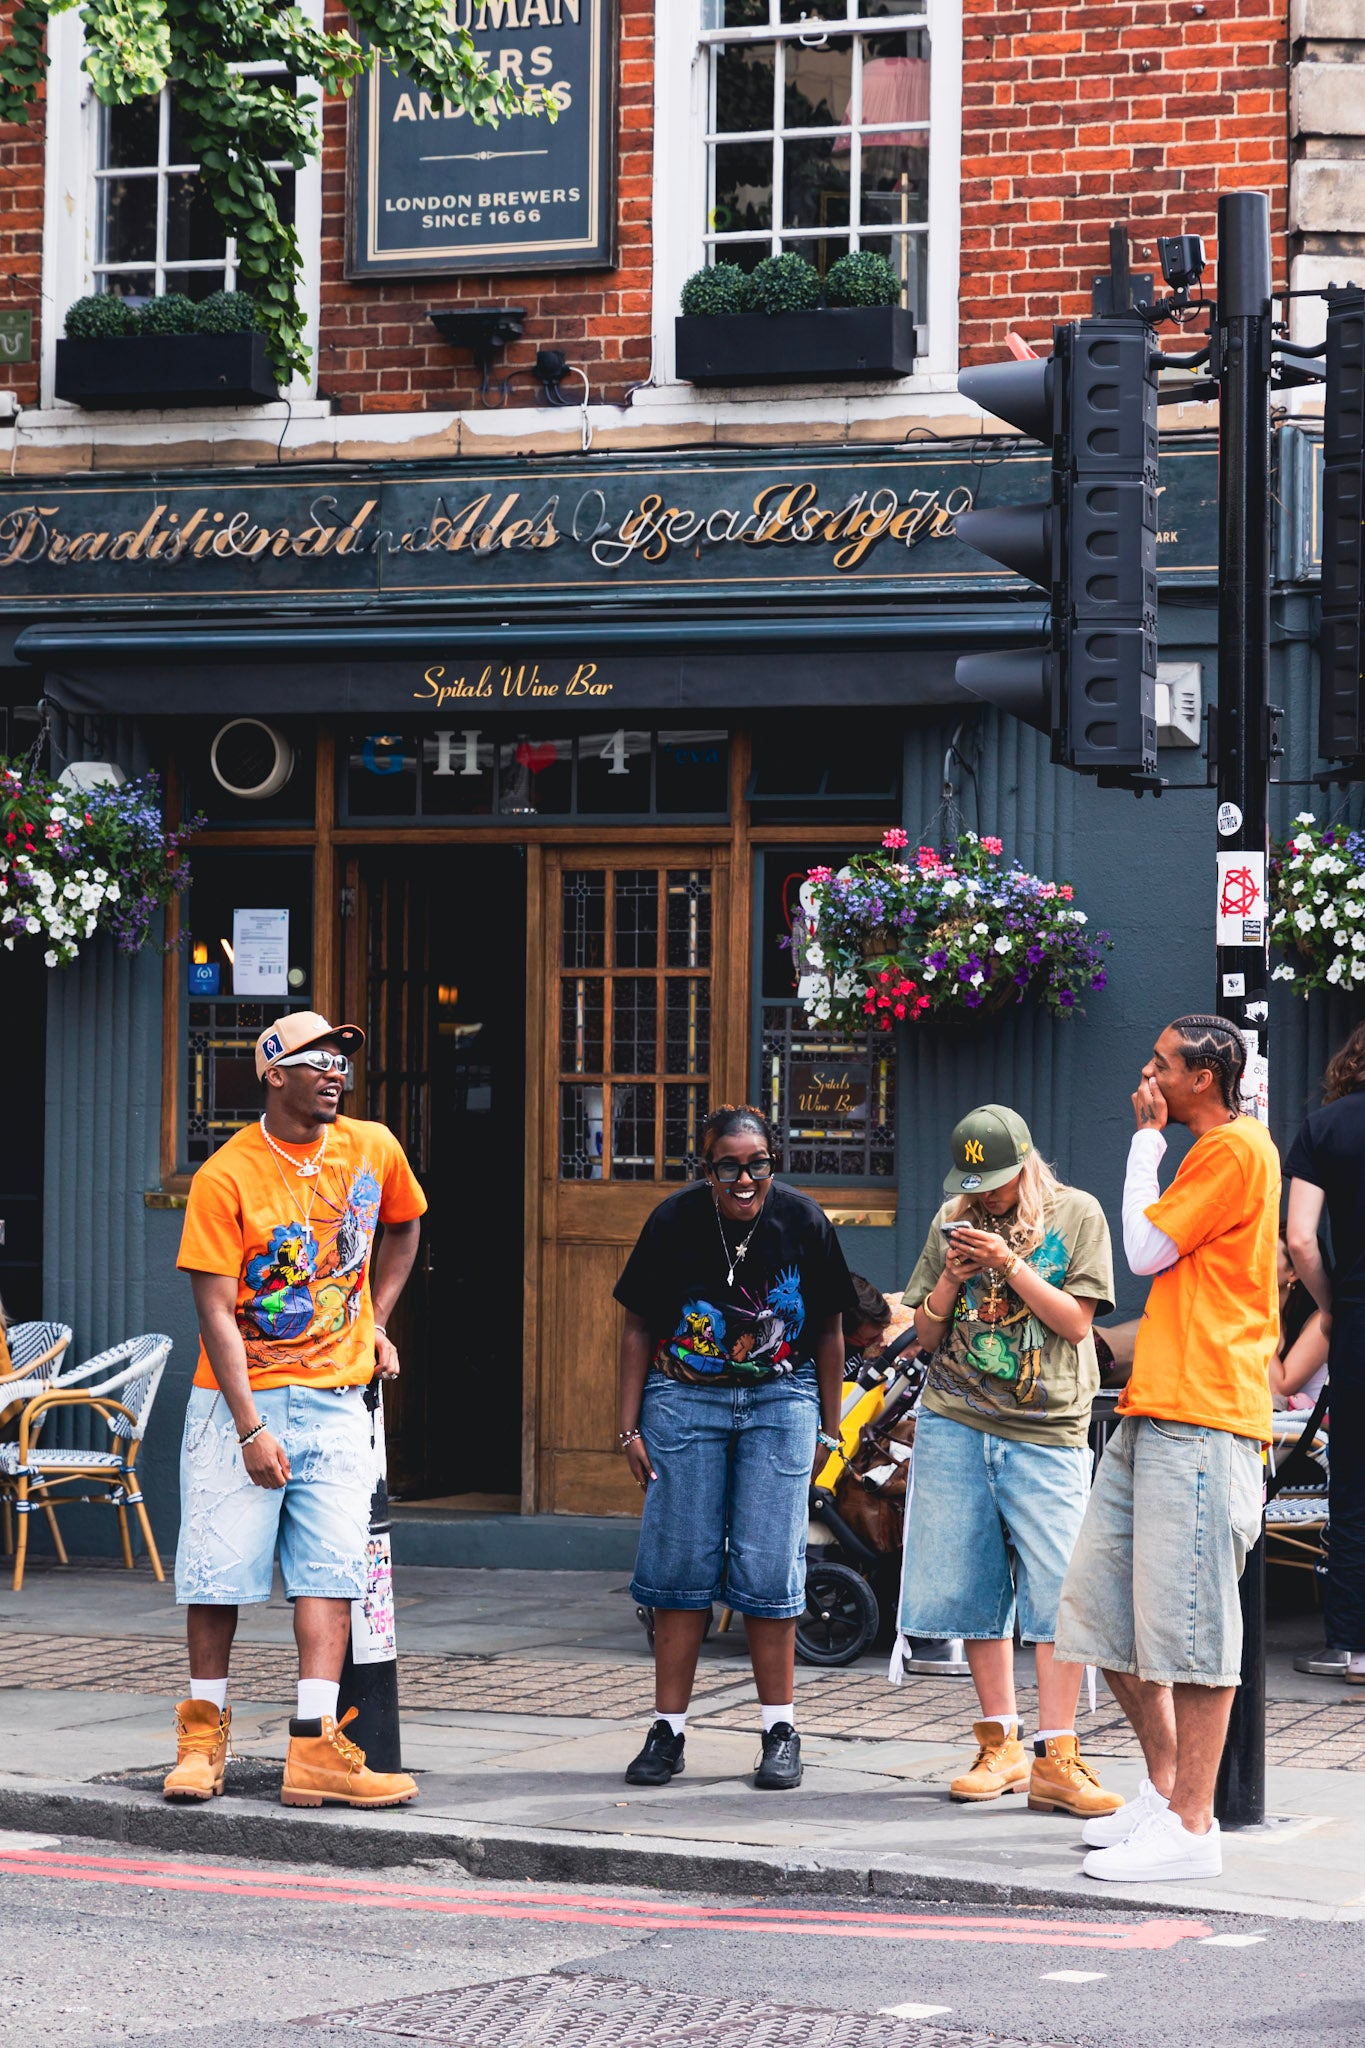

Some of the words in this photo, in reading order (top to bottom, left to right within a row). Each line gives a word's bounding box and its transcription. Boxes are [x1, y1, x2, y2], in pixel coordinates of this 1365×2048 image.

[446, 0, 580, 32] UMAN
[385, 194, 472, 212] LONDON
[478, 187, 581, 208] BREWERS
[422, 212, 482, 228] SINCE
[489, 209, 541, 225] 1666
[742, 482, 958, 569] Lager
[1156, 531, 1178, 543] ARK
[413, 665, 493, 708] Spitals
[500, 664, 559, 697] Wine
[565, 663, 613, 696] Bar
[808, 1072, 850, 1094] Spitals
[798, 1094, 830, 1111] Wine
[834, 1094, 857, 1112] Bar
